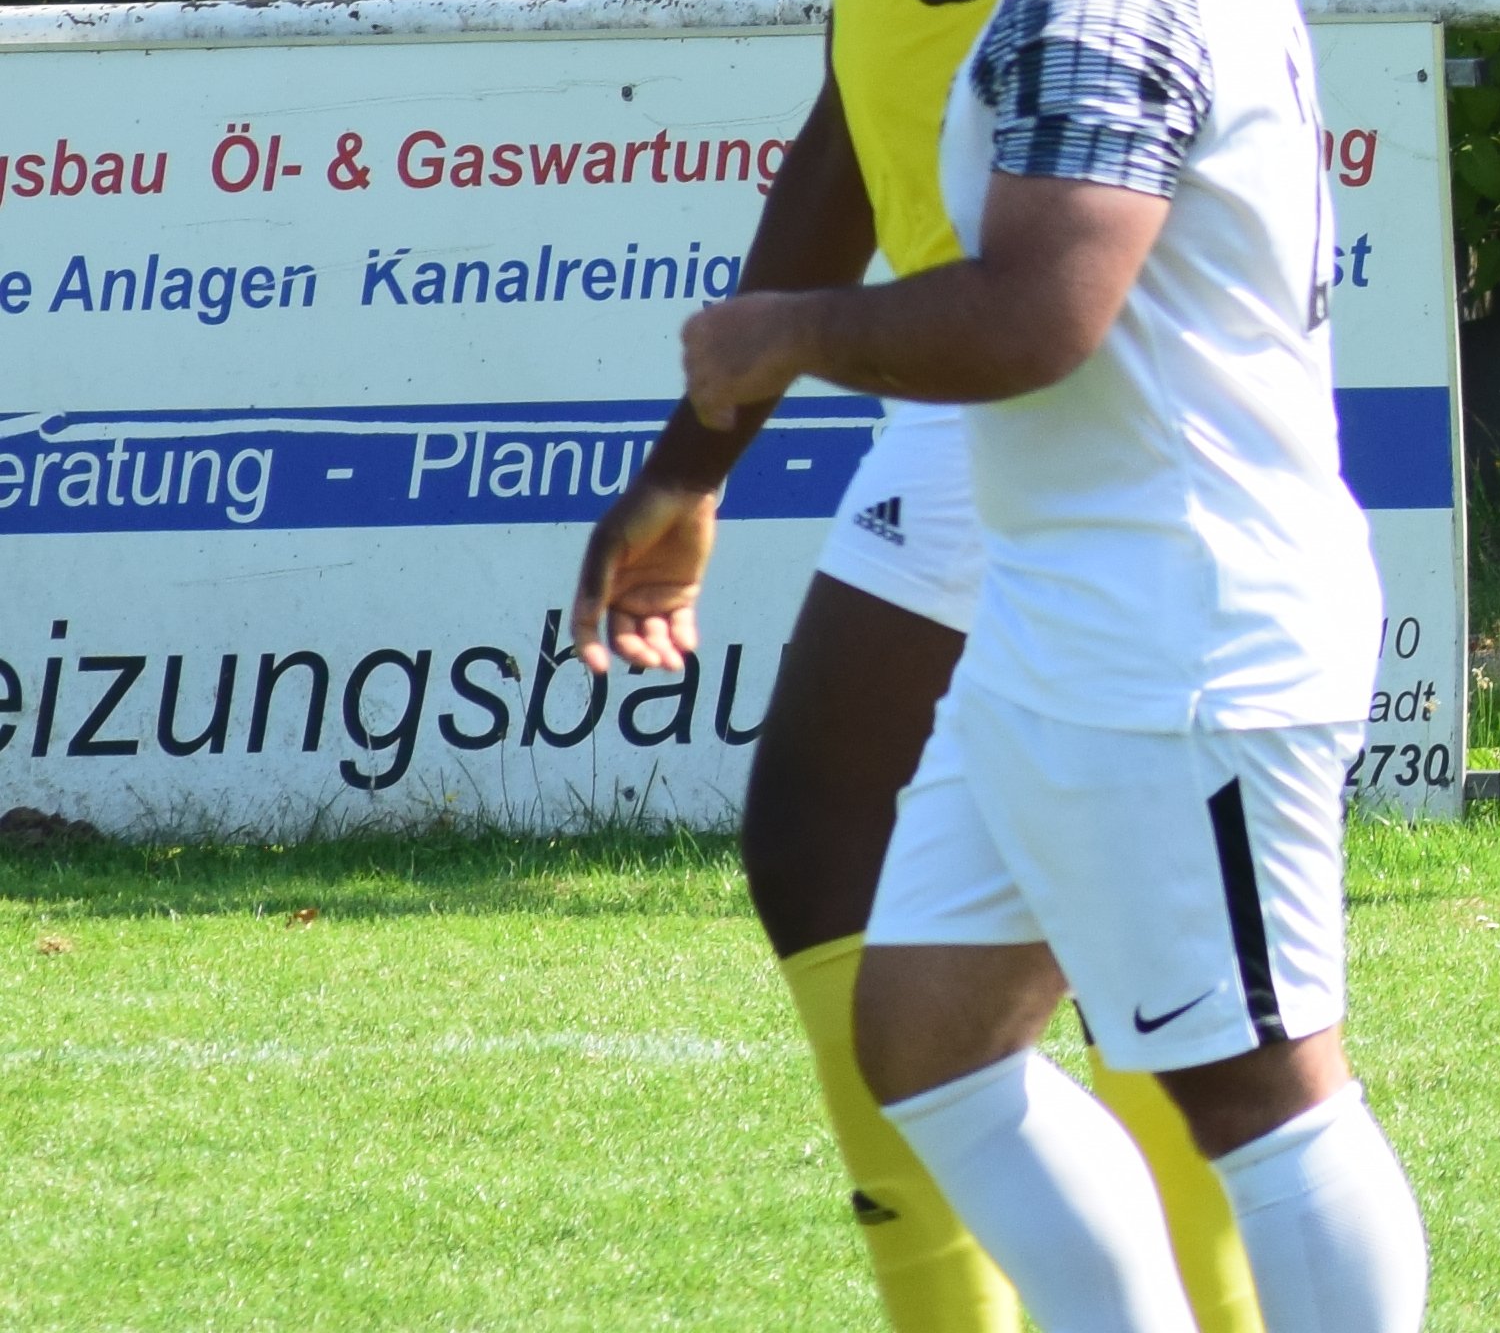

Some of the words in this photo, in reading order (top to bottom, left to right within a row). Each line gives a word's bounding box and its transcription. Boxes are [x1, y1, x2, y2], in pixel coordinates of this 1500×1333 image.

[0, 138, 167, 205] sbau
[212, 123, 302, 192] Öl-
[327, 132, 371, 191] &
[49, 253, 317, 326] Anlagen
